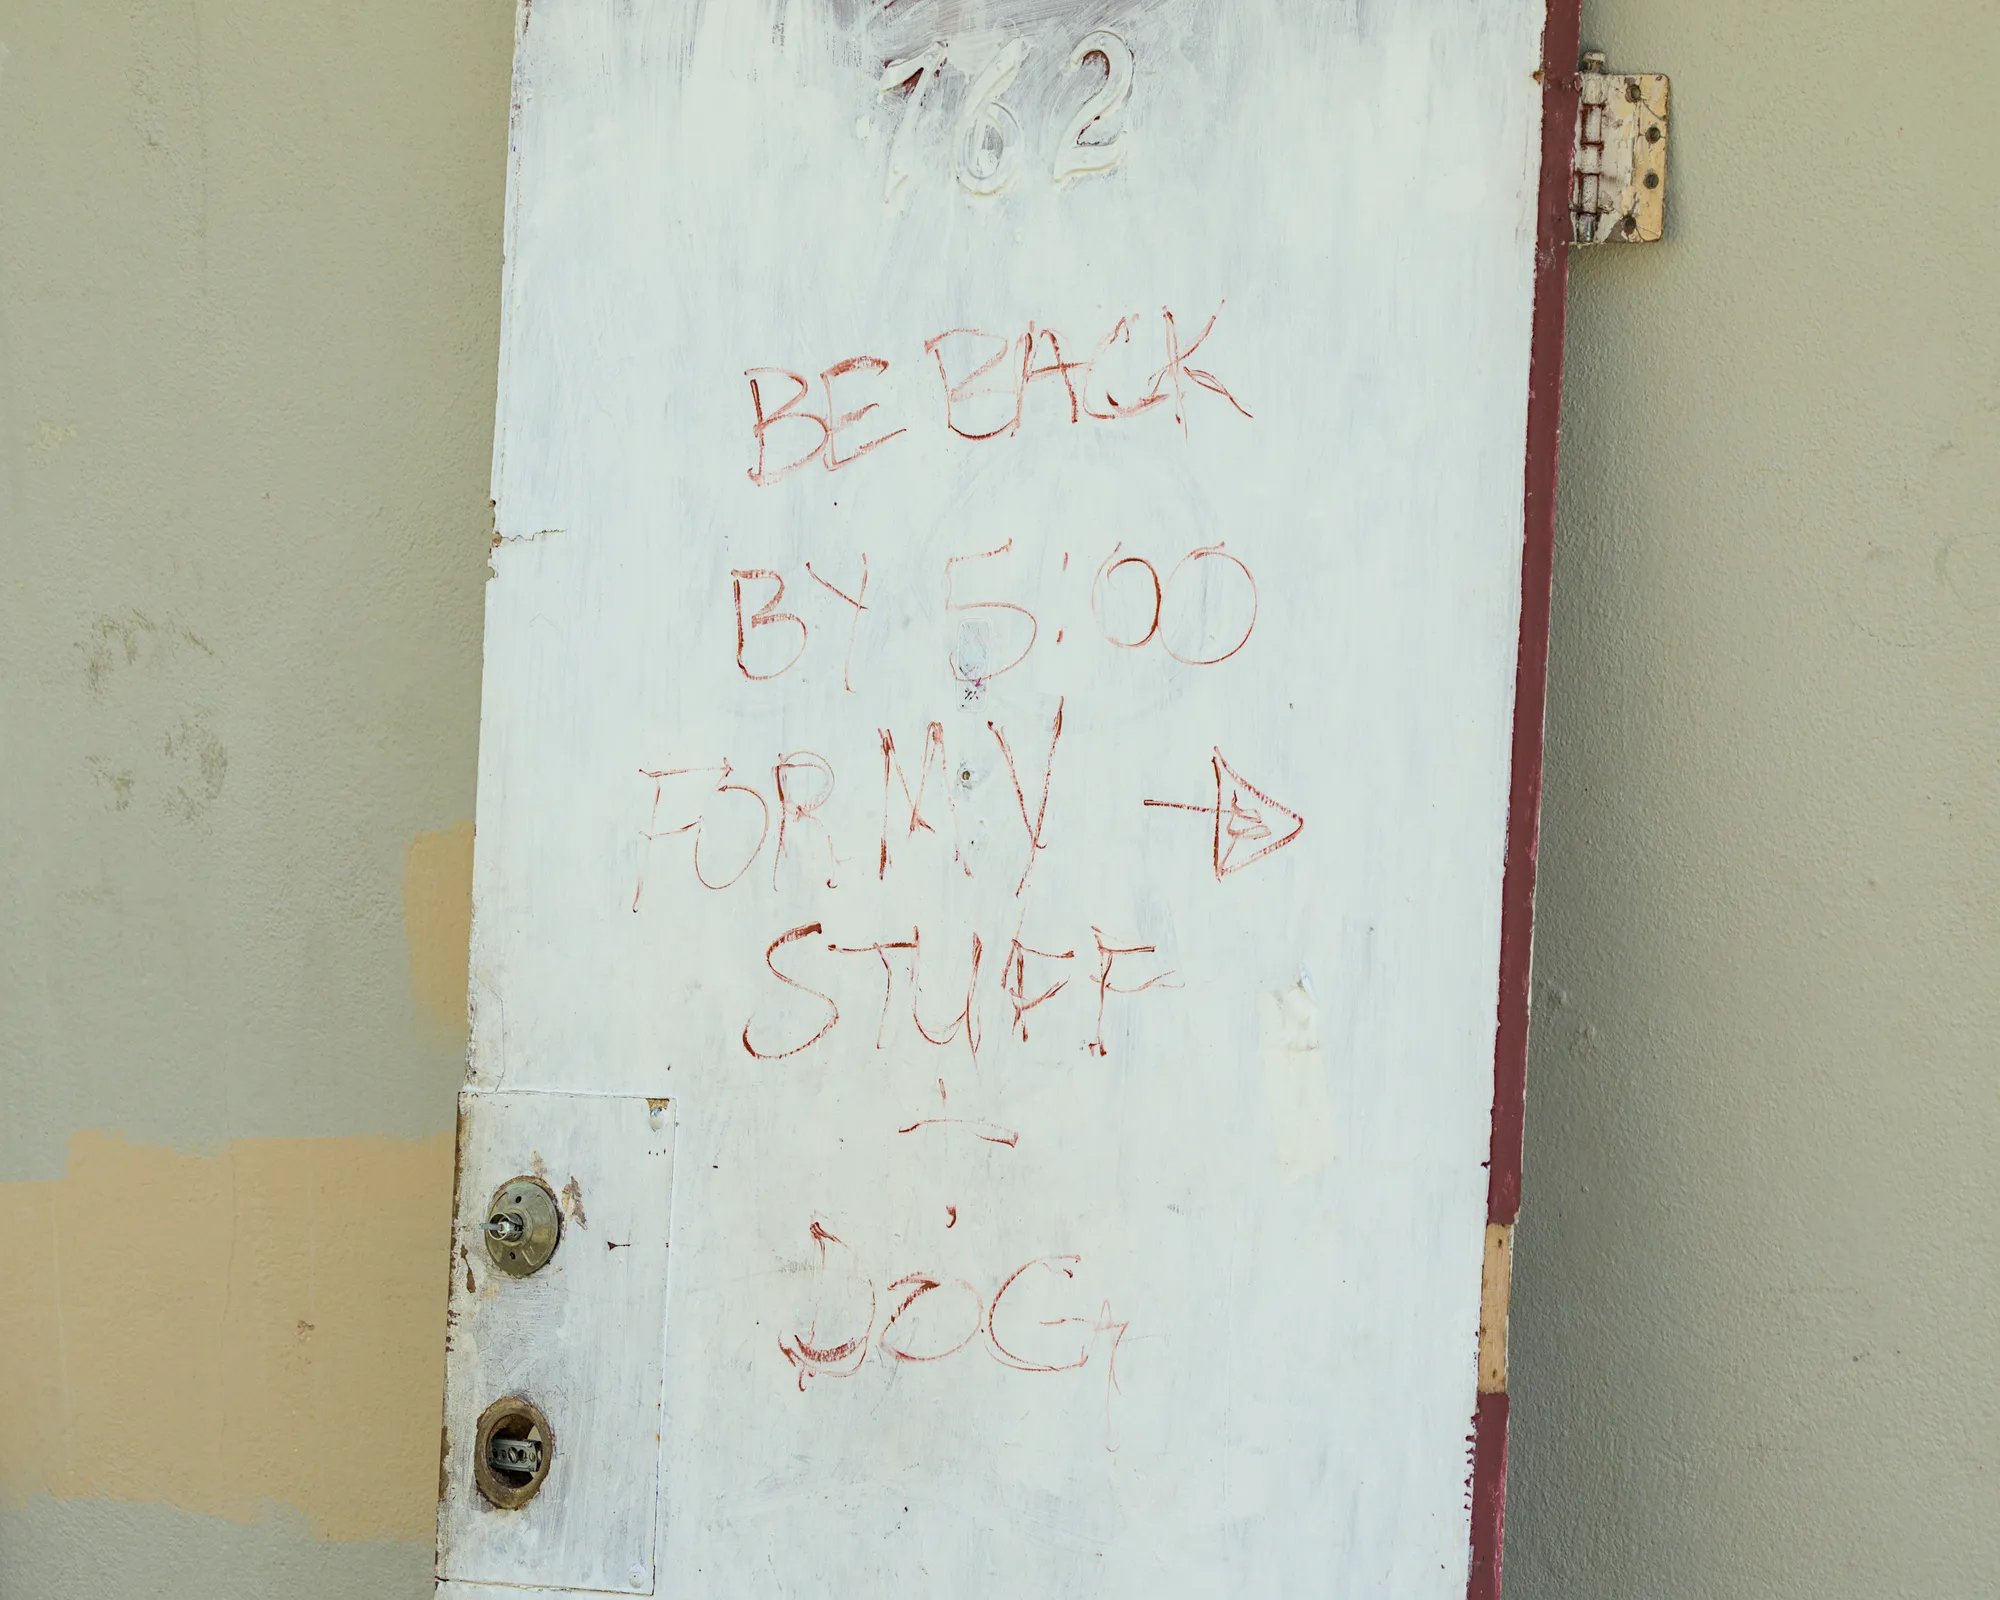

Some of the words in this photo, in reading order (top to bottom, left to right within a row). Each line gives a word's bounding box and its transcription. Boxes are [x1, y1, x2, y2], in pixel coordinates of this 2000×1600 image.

[880, 30, 1135, 203] 162
[744, 355, 907, 486] BE
[924, 299, 1253, 442] BACK
[731, 553, 868, 693] BY
[945, 538, 1257, 683] 5:00
[631, 751, 839, 913] FOR
[877, 696, 1064, 898] MY
[742, 922, 1185, 1060] STUFF
[777, 1218, 1129, 1394] DOG
